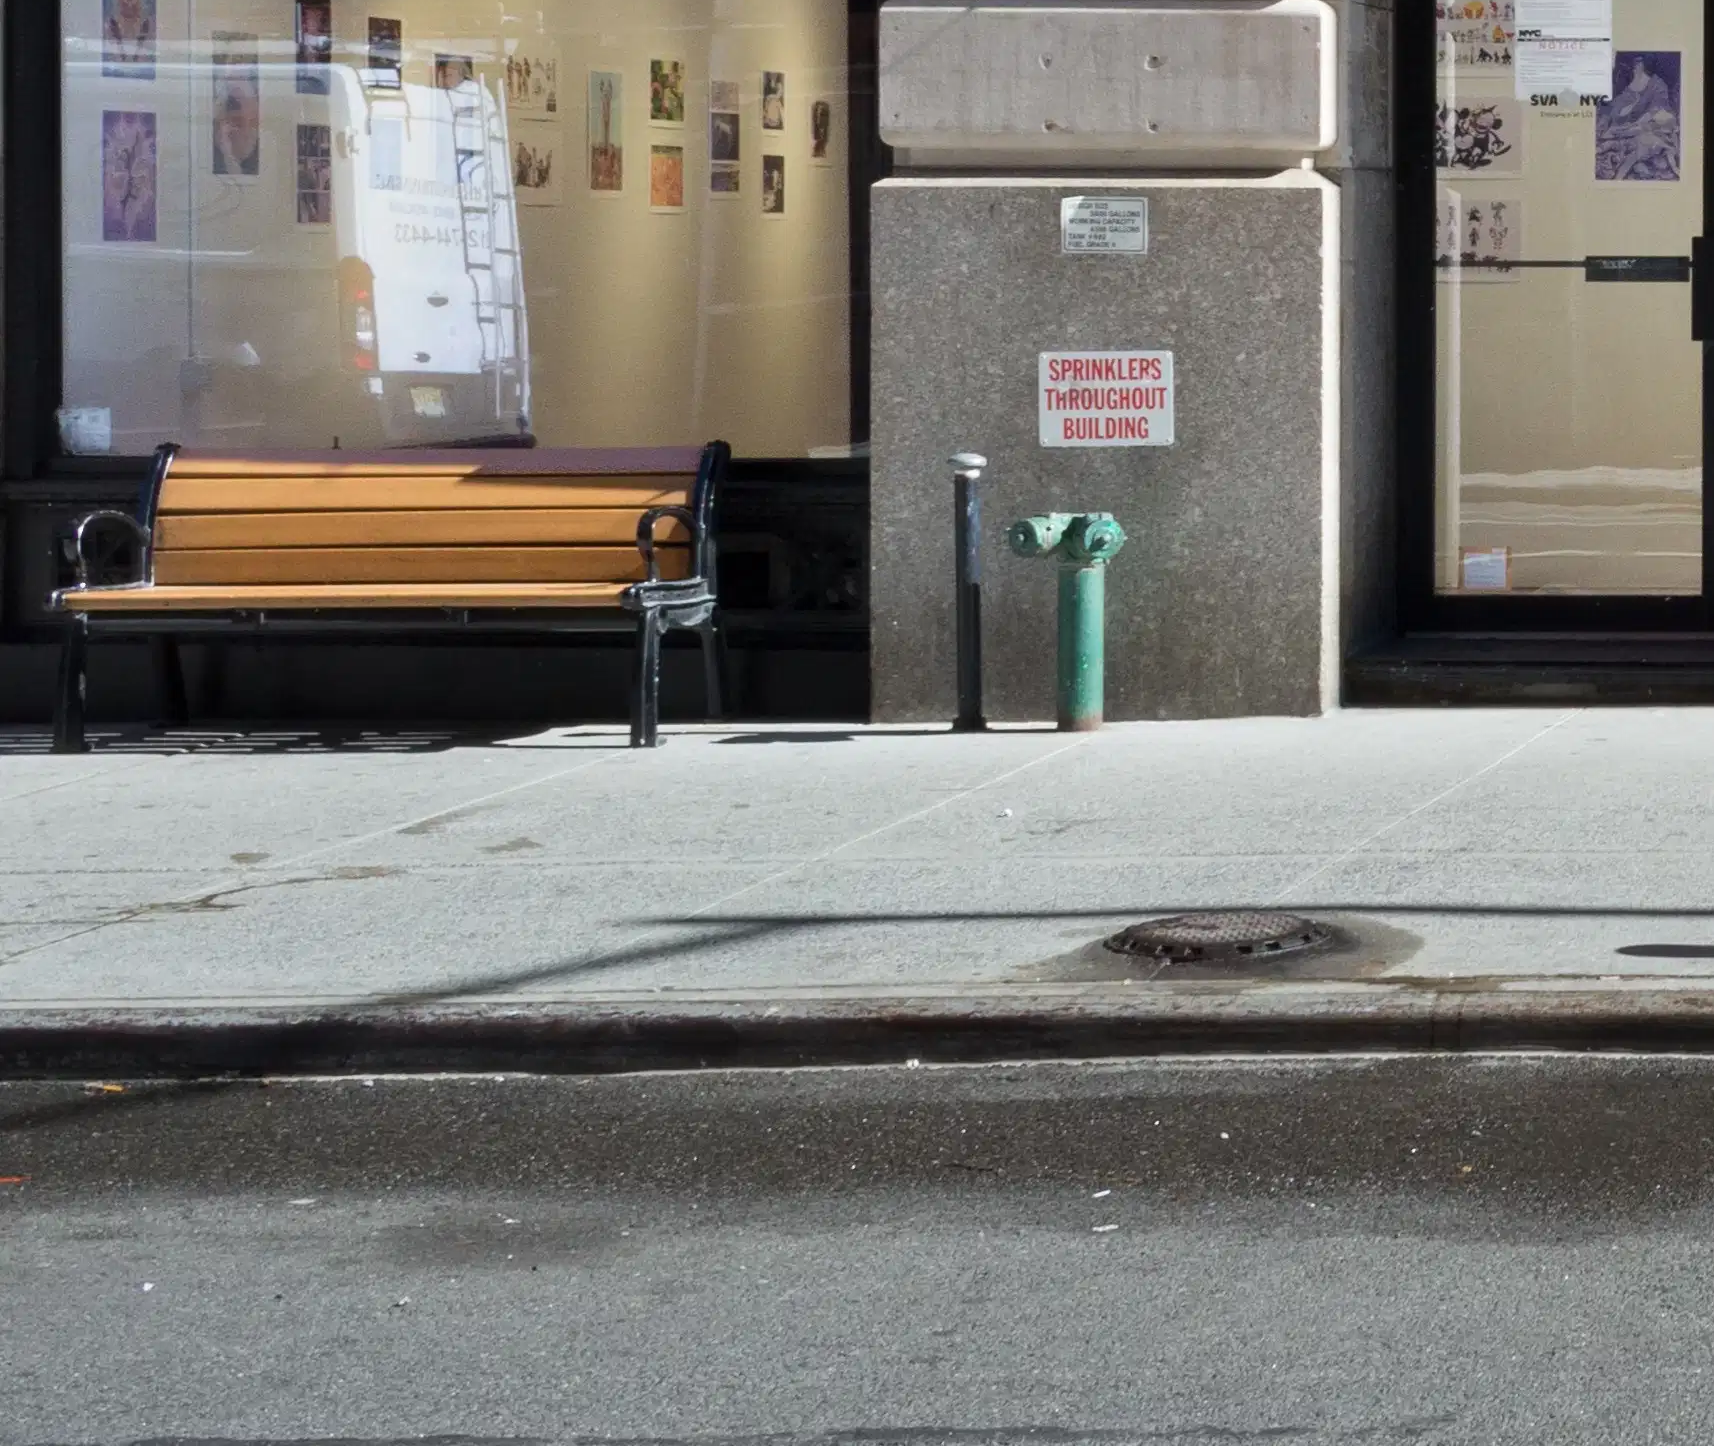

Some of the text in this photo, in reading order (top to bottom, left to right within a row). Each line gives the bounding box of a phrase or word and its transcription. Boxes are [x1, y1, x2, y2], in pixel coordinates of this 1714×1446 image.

[1538, 41, 1585, 50] NOTICE
[1530, 93, 1609, 106] SVA NYC
[1048, 358, 1162, 382] SPRINKLERS
[1044, 387, 1167, 411] THROUGHOUT
[1063, 416, 1149, 440] BUILDING
